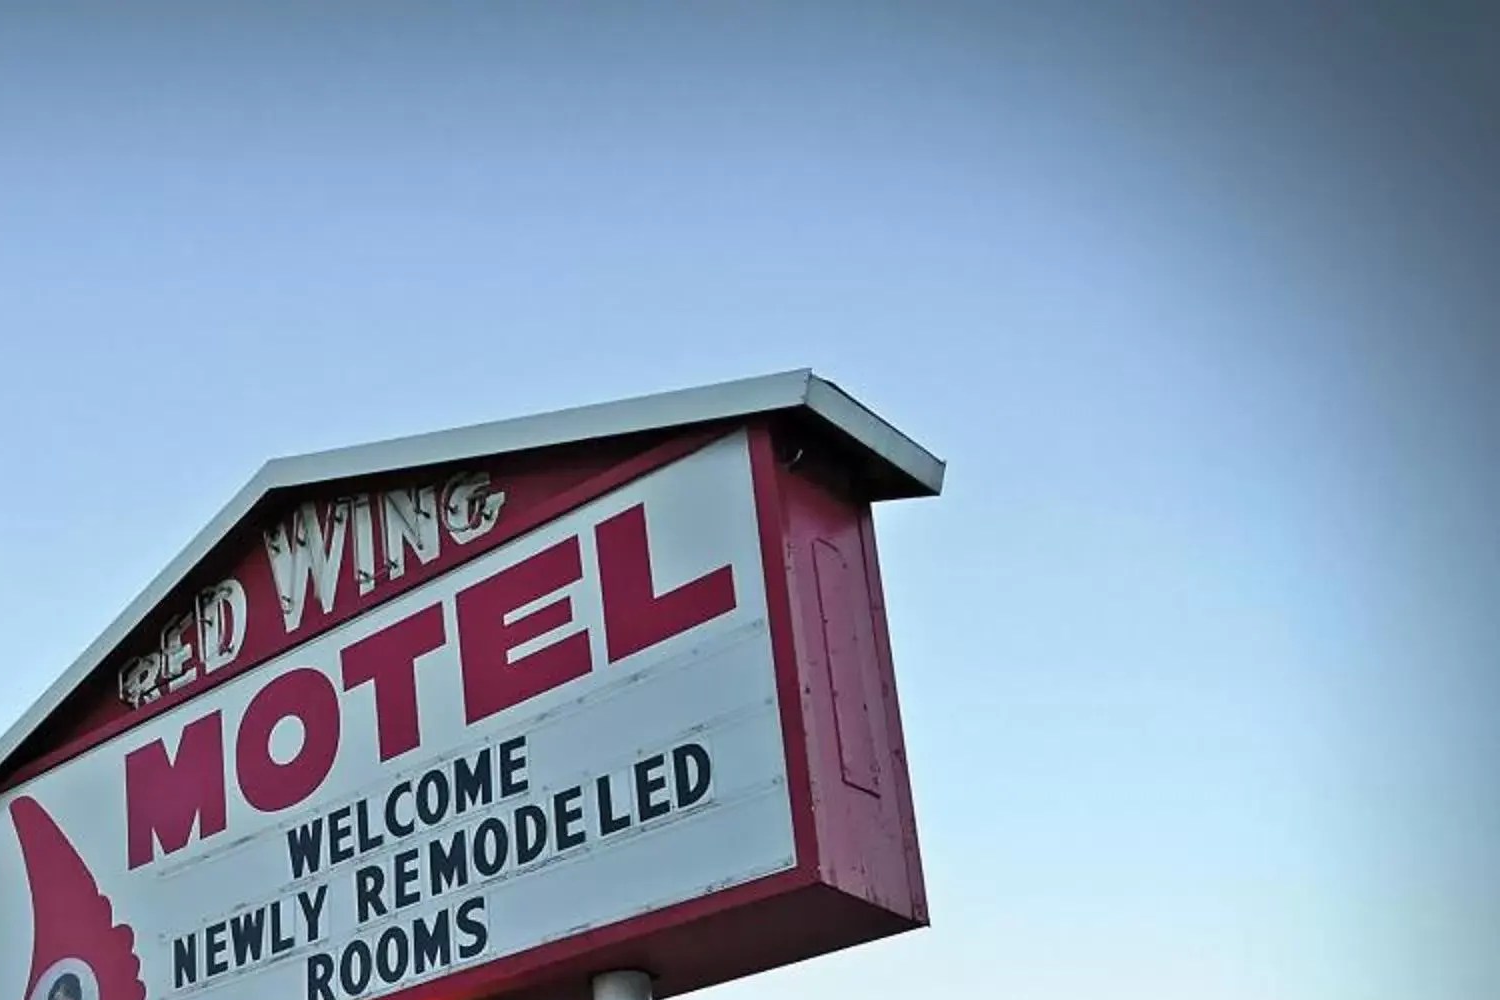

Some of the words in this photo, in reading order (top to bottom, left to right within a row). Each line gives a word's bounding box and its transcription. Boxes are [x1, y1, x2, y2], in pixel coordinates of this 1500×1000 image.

[119, 578, 248, 709] RED
[263, 471, 506, 634] WING
[124, 503, 738, 872] MOTEL
[172, 883, 328, 990] NEWLY
[356, 743, 713, 925] REMODELED
[288, 737, 530, 880] WELCOME
